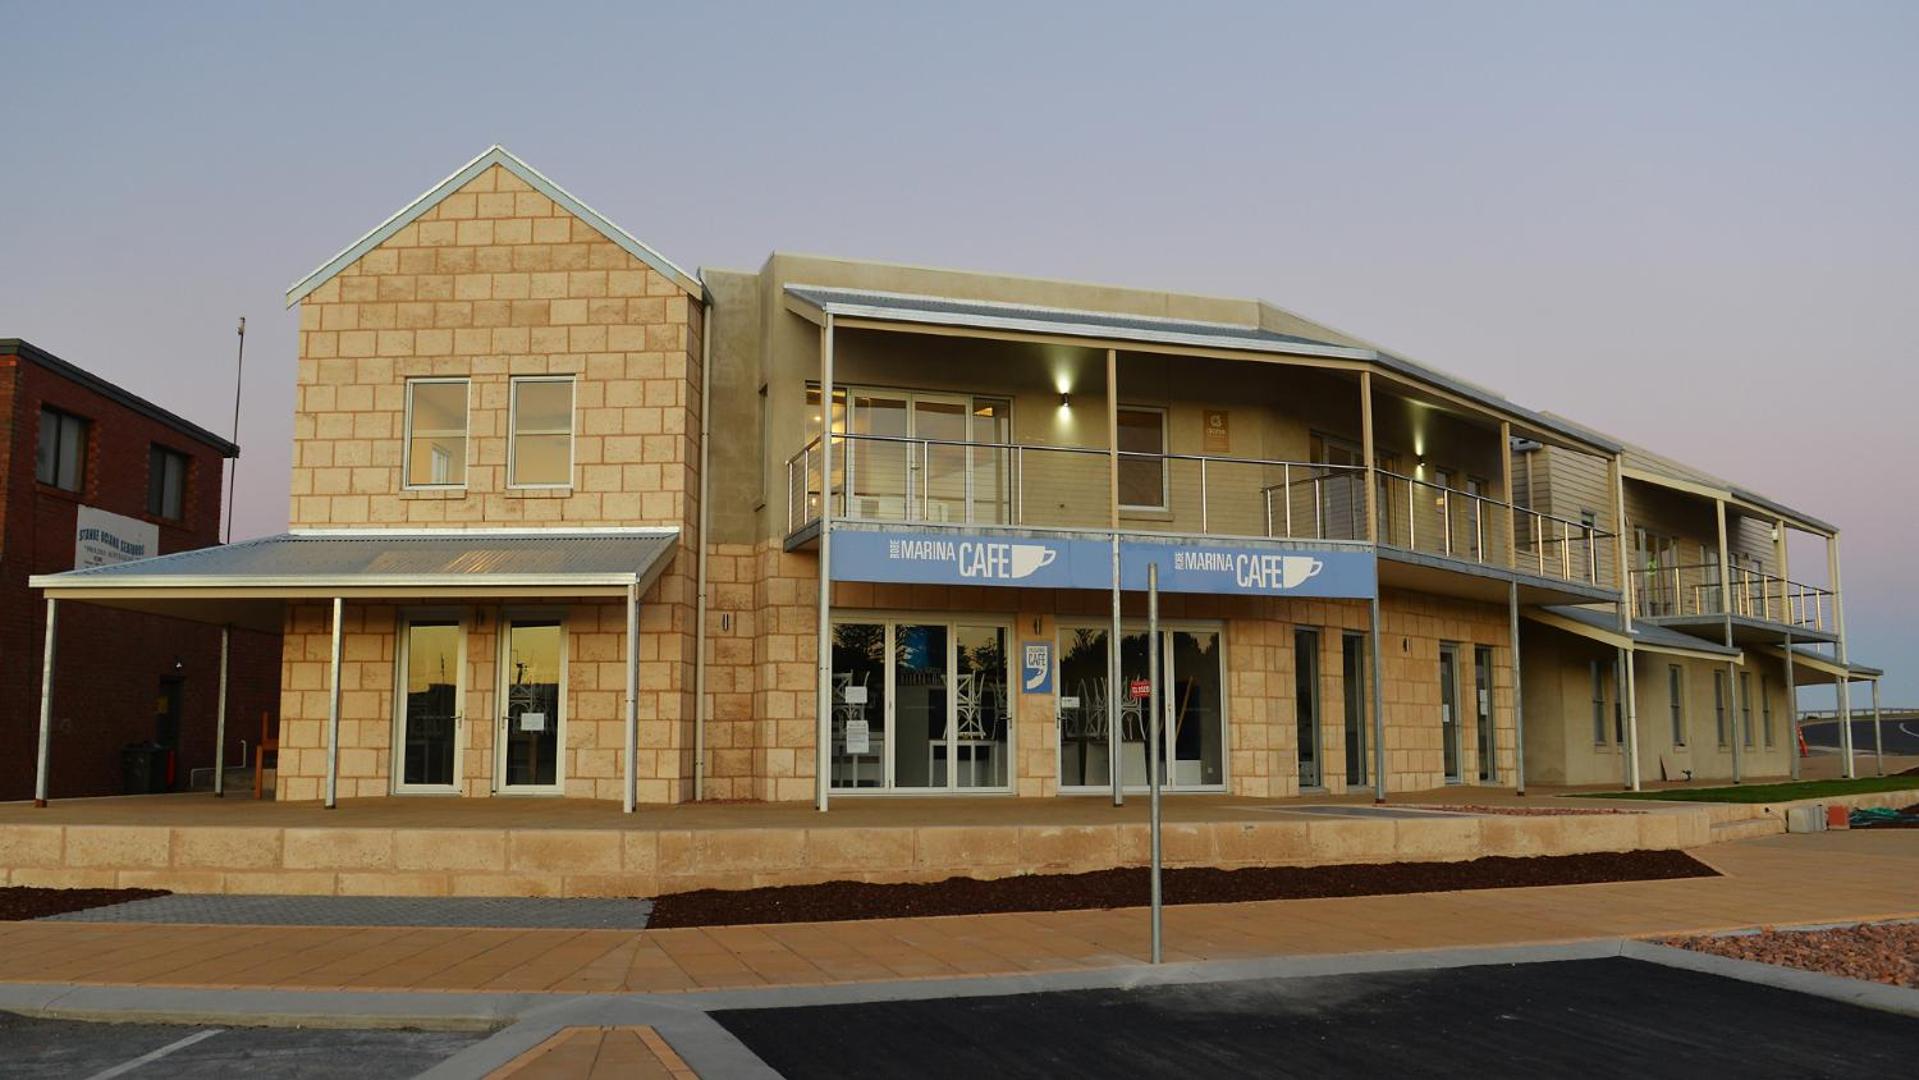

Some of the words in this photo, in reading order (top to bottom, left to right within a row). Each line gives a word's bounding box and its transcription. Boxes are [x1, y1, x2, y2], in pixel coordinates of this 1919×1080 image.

[890, 538, 900, 559] ROBE
[901, 539, 956, 561] MARINA
[959, 542, 1010, 578] CAFE
[1185, 552, 1234, 572] MARINA
[1236, 554, 1283, 588] CAFE
[1028, 653, 1046, 666] CAFE
